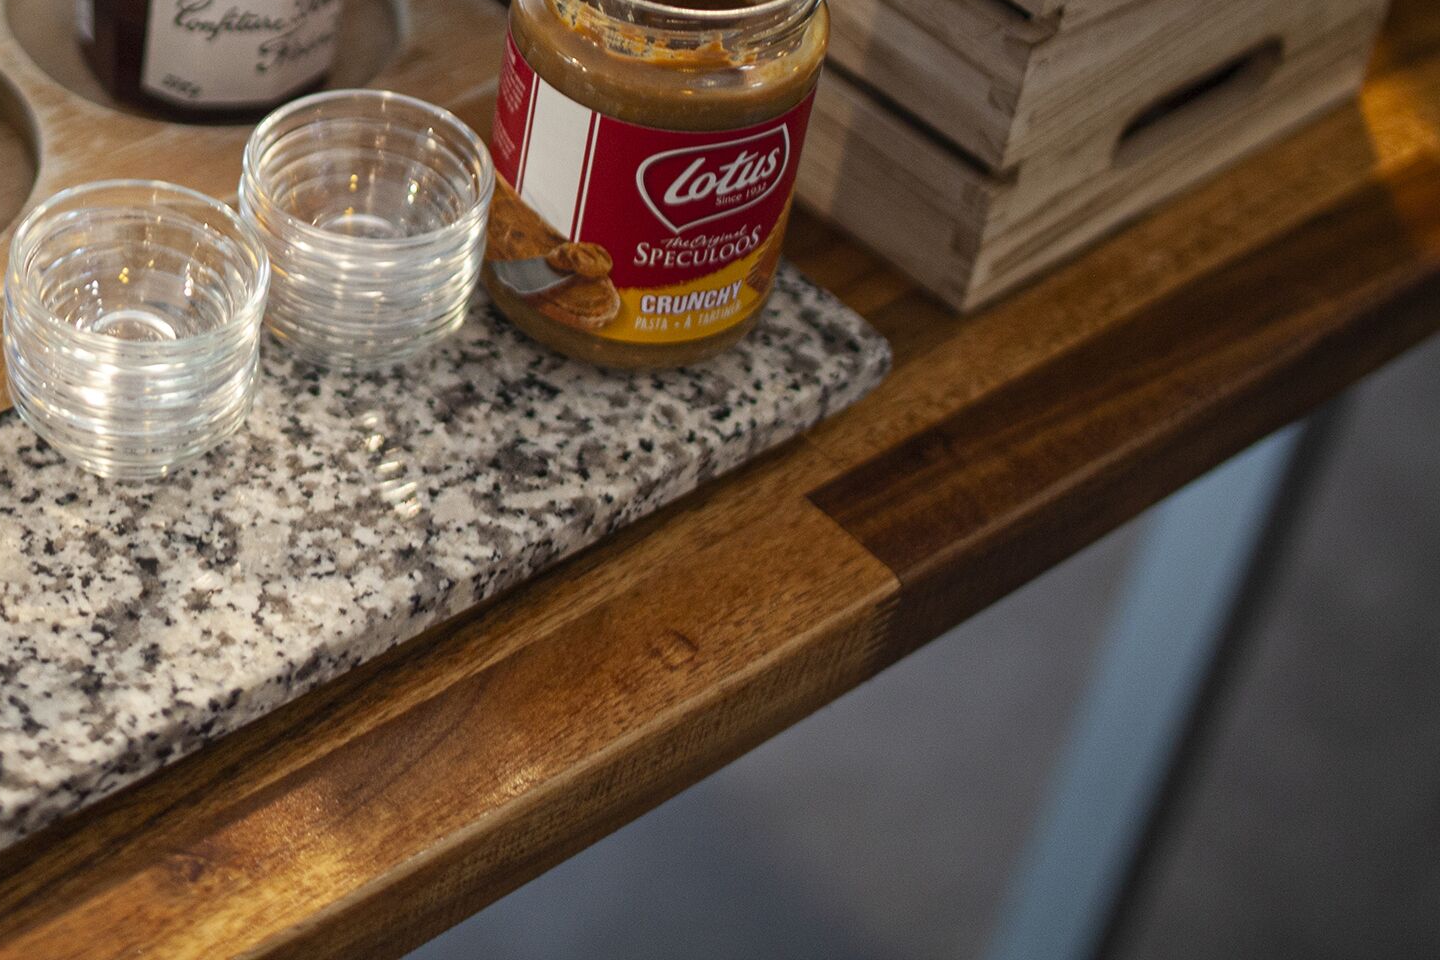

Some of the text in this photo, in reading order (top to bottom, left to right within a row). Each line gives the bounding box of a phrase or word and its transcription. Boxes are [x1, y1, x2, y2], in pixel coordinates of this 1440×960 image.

[663, 146, 780, 206] Lotus
[715, 192, 743, 207] Since
[641, 279, 743, 315] CRUNCHY
[634, 316, 669, 332] PASTA
